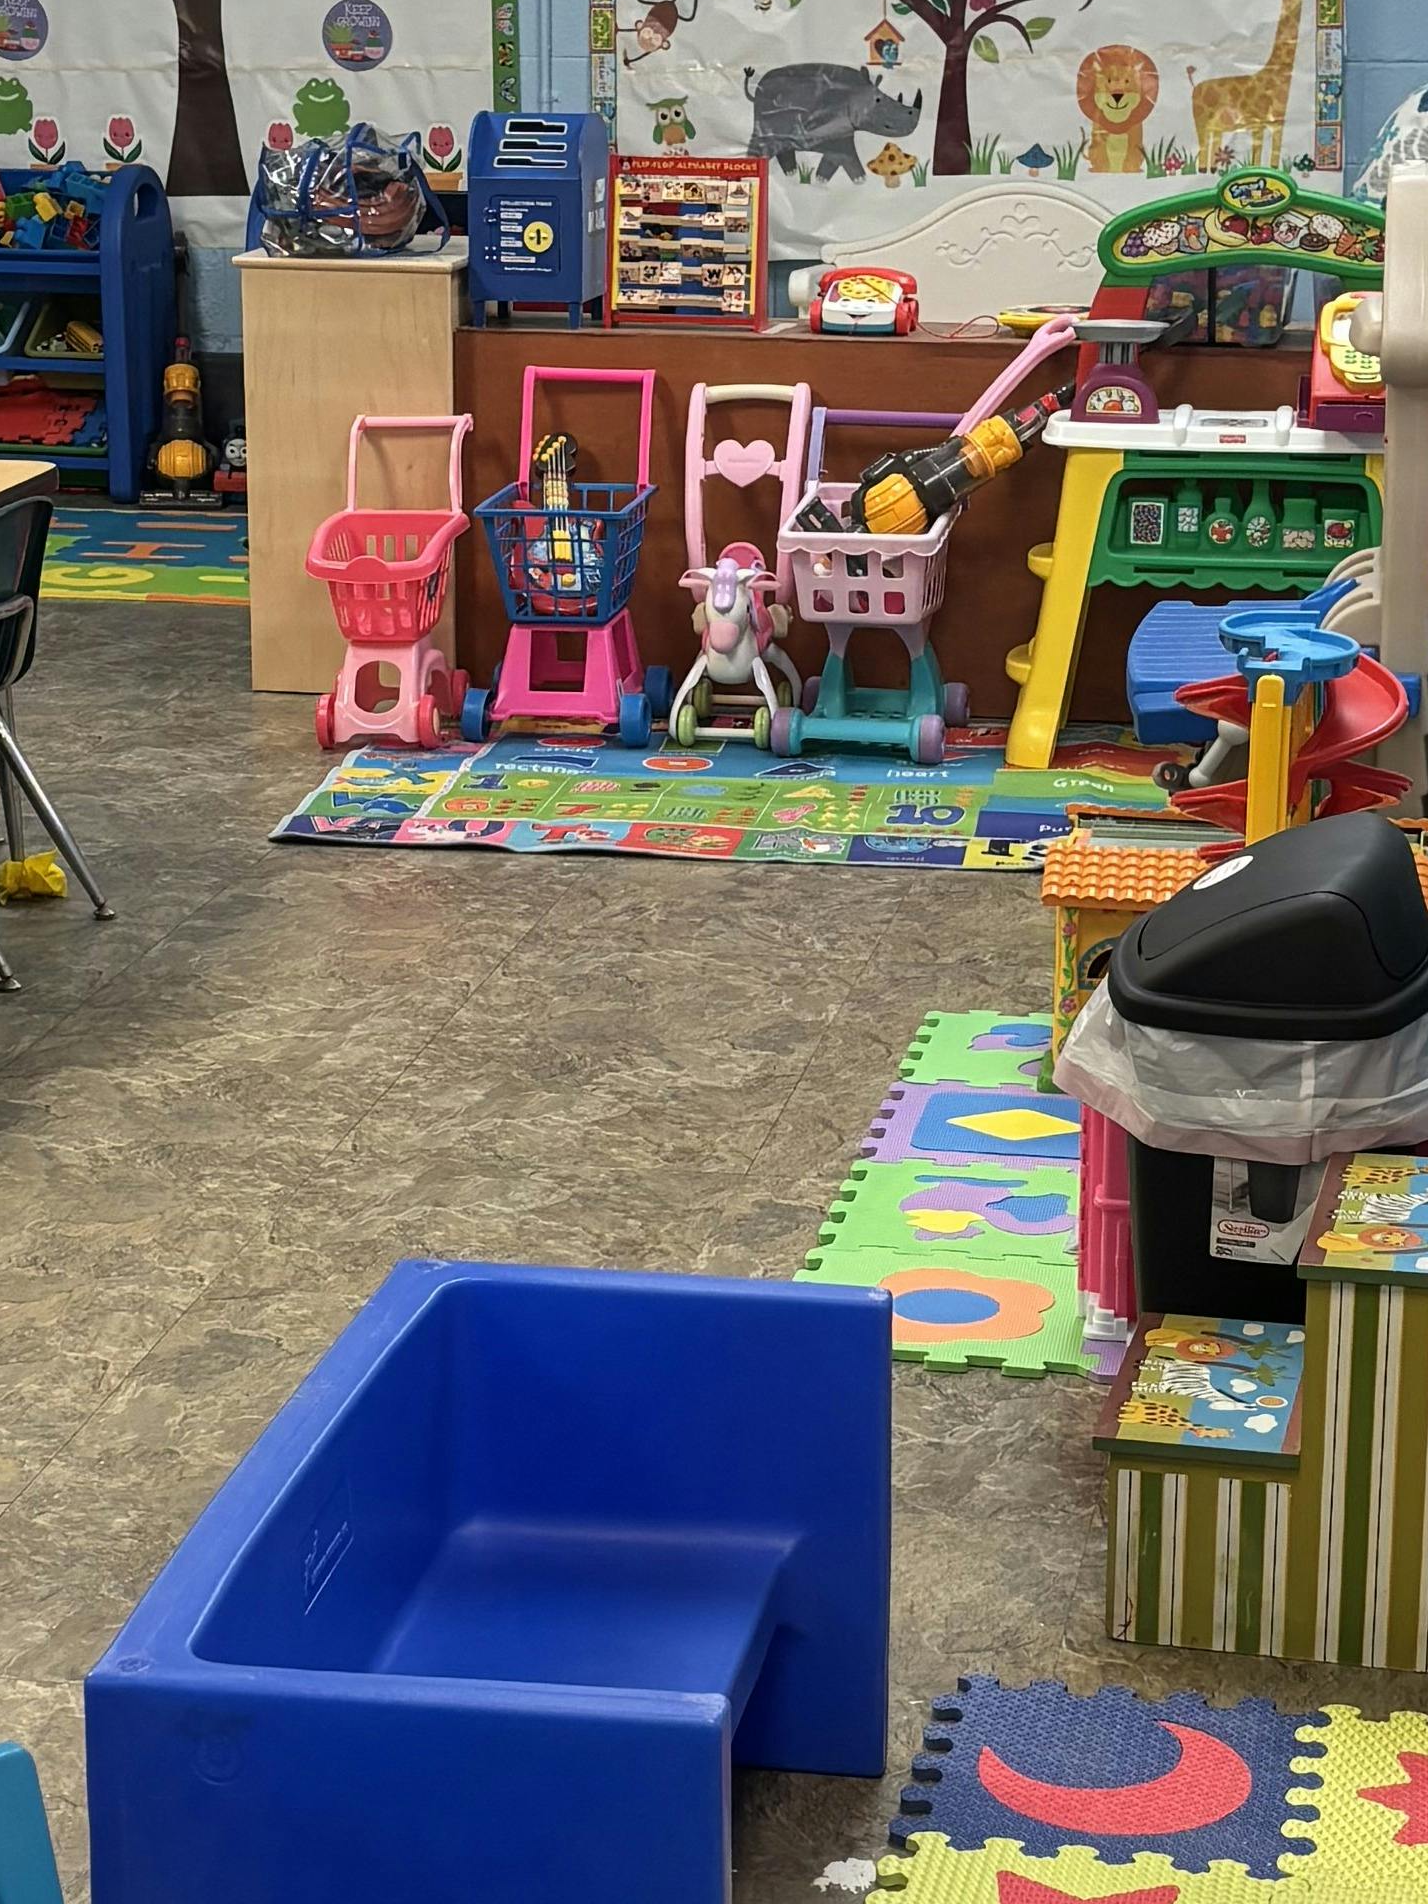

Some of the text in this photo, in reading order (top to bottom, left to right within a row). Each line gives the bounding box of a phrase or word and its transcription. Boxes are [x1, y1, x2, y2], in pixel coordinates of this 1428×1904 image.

[344, 3, 373, 16] KEEP
[676, 161, 721, 171] ALPHABET
[723, 162, 758, 172] BLOCKS
[886, 768, 951, 779] heart
[1052, 777, 1115, 793] Green
[884, 803, 966, 827] 10
